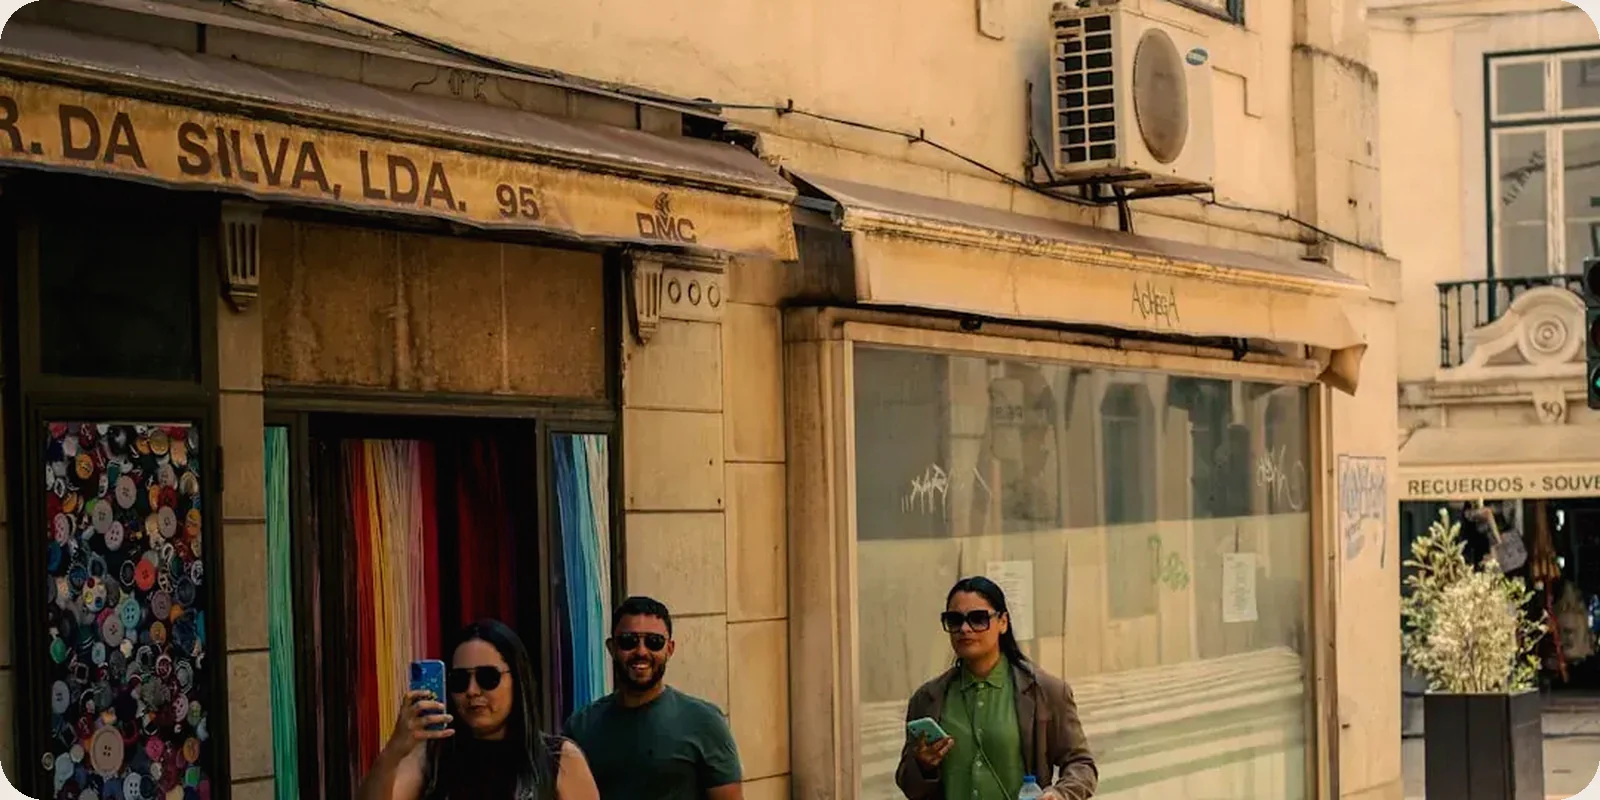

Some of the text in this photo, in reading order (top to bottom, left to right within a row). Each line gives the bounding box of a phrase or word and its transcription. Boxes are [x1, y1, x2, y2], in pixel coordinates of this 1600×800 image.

[0, 95, 540, 220] R. DA SILVA, LDA. 95
[636, 212, 697, 243] DMC
[1408, 477, 1524, 495] RECUERDOS
